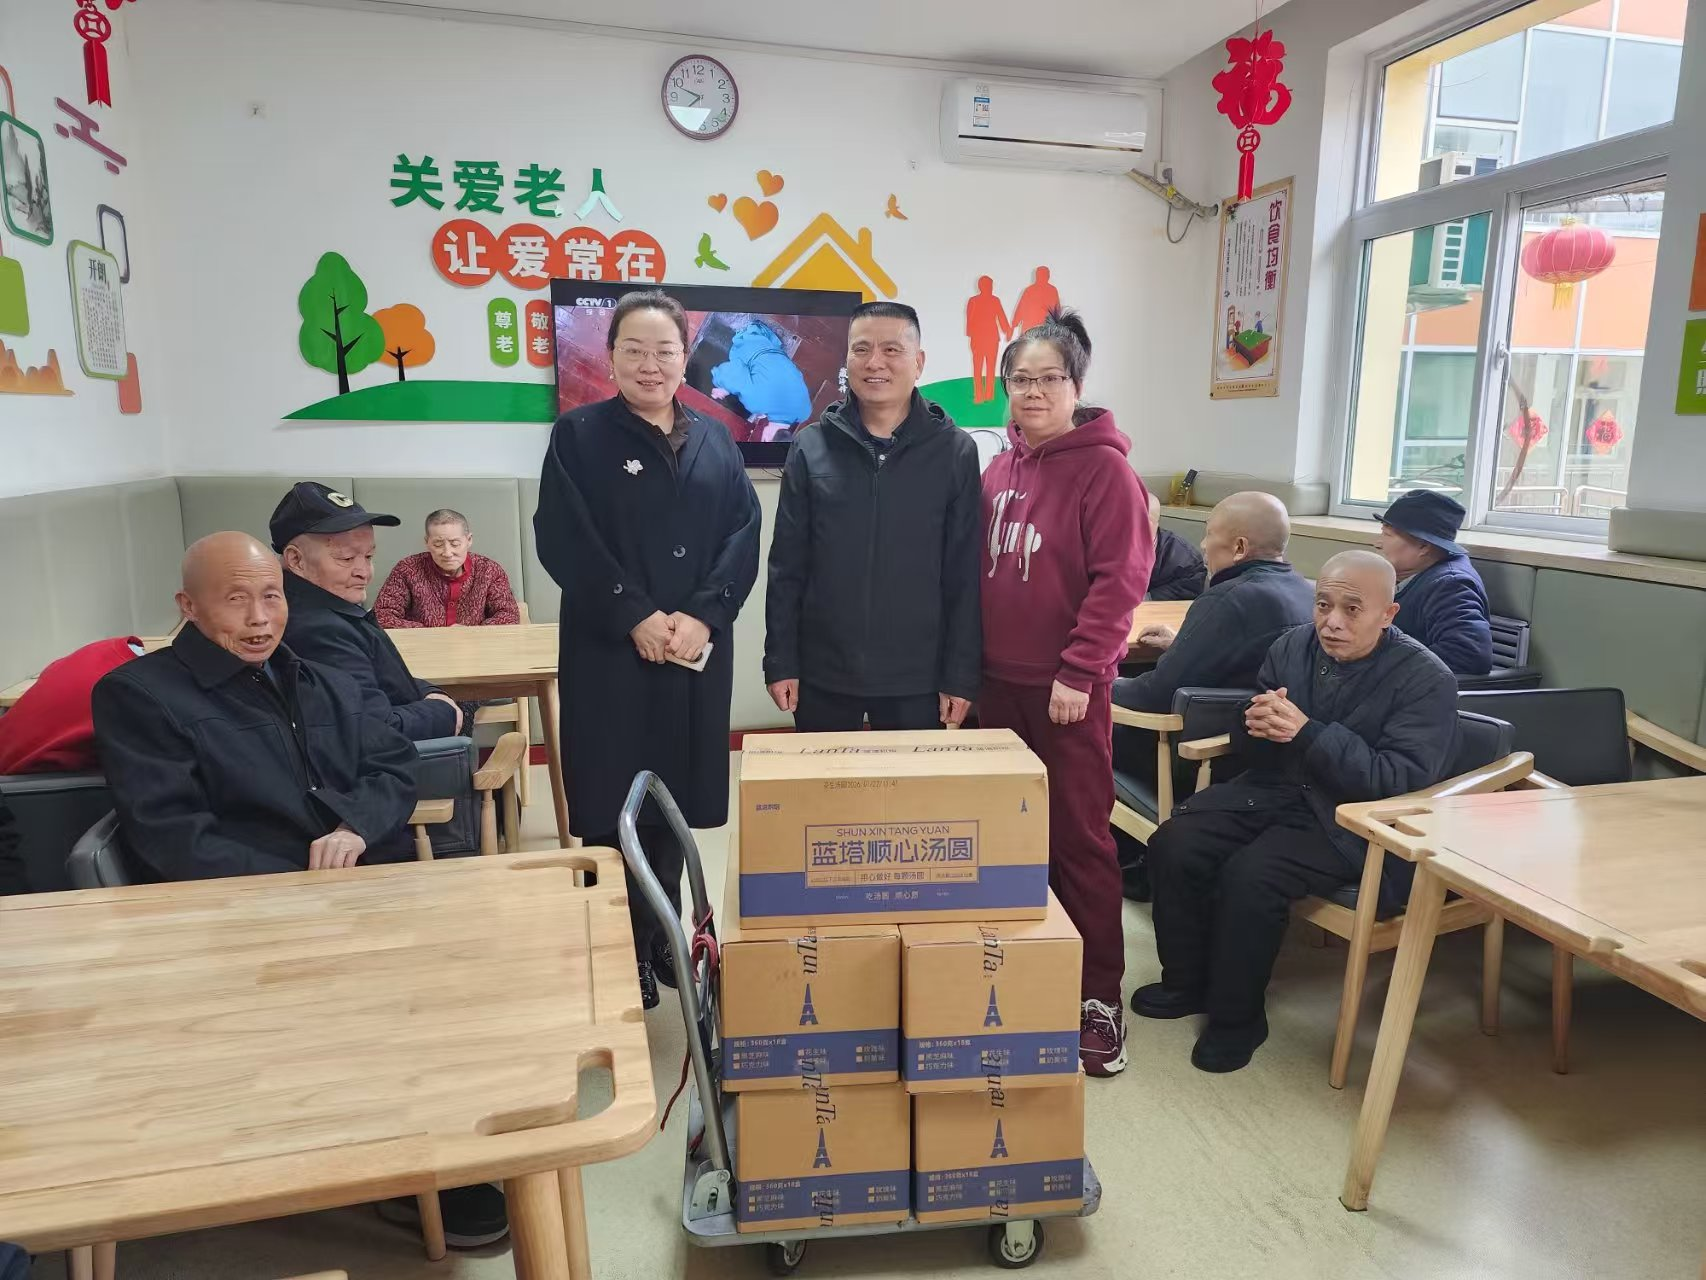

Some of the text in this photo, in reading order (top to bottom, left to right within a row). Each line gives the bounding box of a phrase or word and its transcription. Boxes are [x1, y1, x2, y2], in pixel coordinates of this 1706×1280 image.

[682, 68, 690, 78] 11
[693, 64, 705, 75] 12
[711, 69, 715, 78] 1
[673, 77, 684, 88] 10
[718, 79, 726, 89] 2
[671, 91, 679, 101] 9
[722, 93, 731, 103] 3
[389, 153, 623, 222] 关爱老人
[1265, 199, 1283, 290] 饮食均衡
[443, 230, 656, 281] 让爱常在
[494, 310, 515, 353] 尊老
[531, 311, 552, 354] 敬老
[836, 825, 950, 837] SHUN XIN TANG YUAN
[811, 837, 973, 866] 蓝塔顺心汤圆
